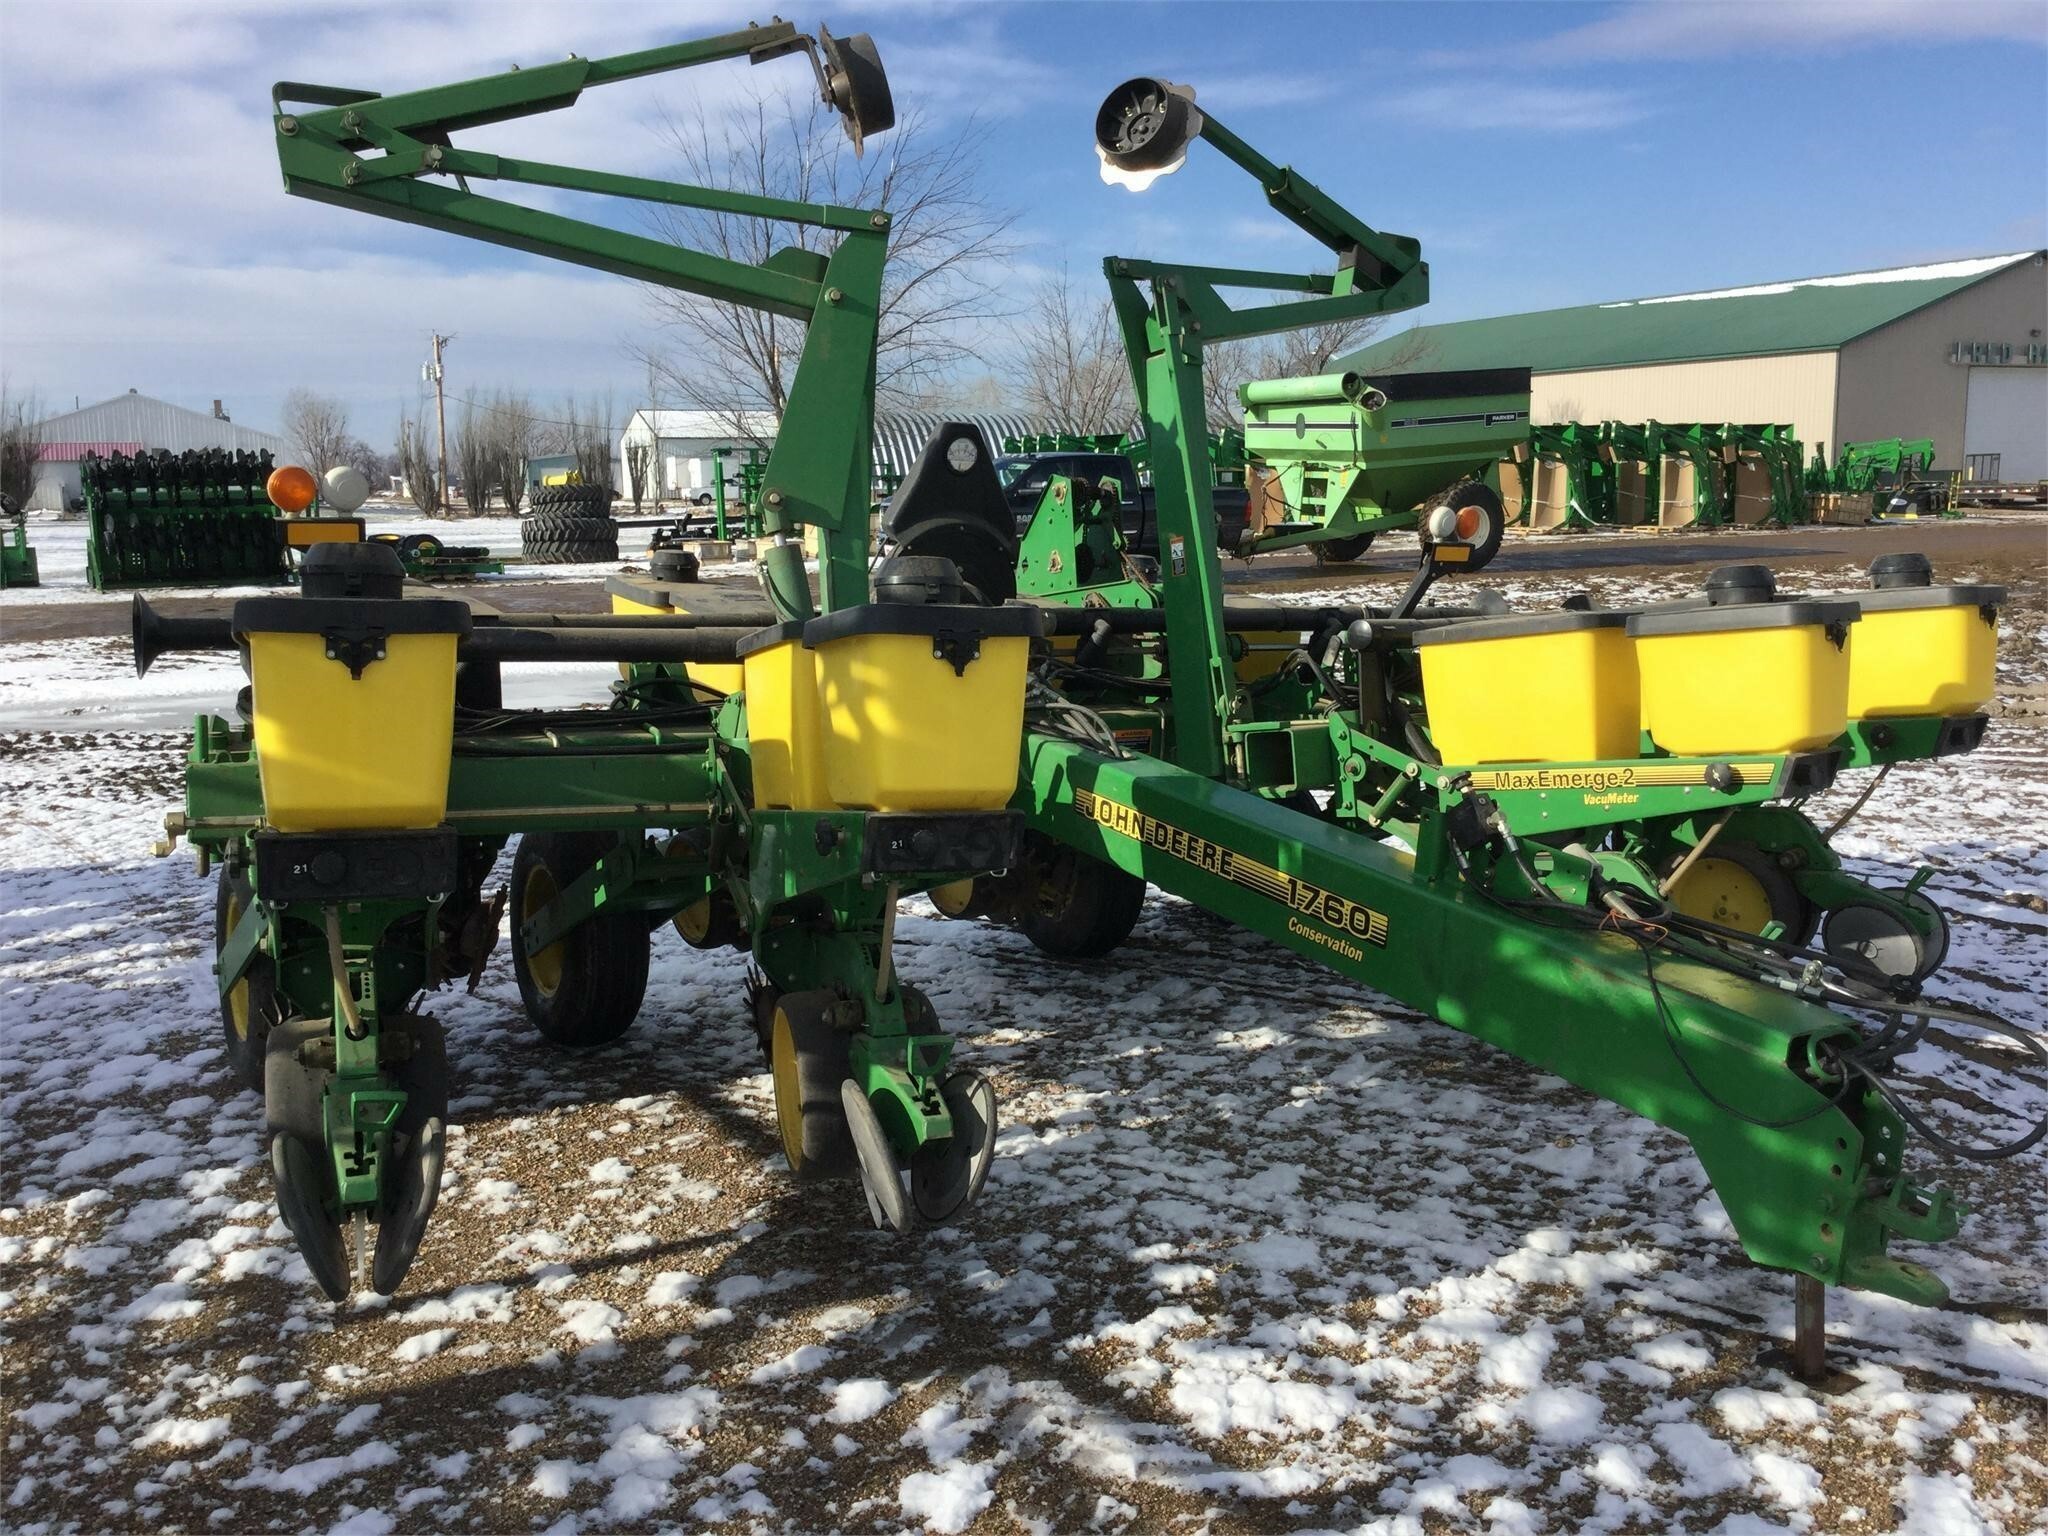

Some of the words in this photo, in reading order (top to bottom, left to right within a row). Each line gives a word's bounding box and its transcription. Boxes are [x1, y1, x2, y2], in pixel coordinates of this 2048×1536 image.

[1494, 769, 1619, 793] MaxEmerge
[1621, 768, 1637, 786] 2
[1583, 792, 1640, 806] VacuMeter
[1084, 793, 1147, 842] JOHN
[1152, 820, 1235, 880] DEERE
[1285, 876, 1373, 940] 1760
[1287, 916, 1364, 962] Conservation
